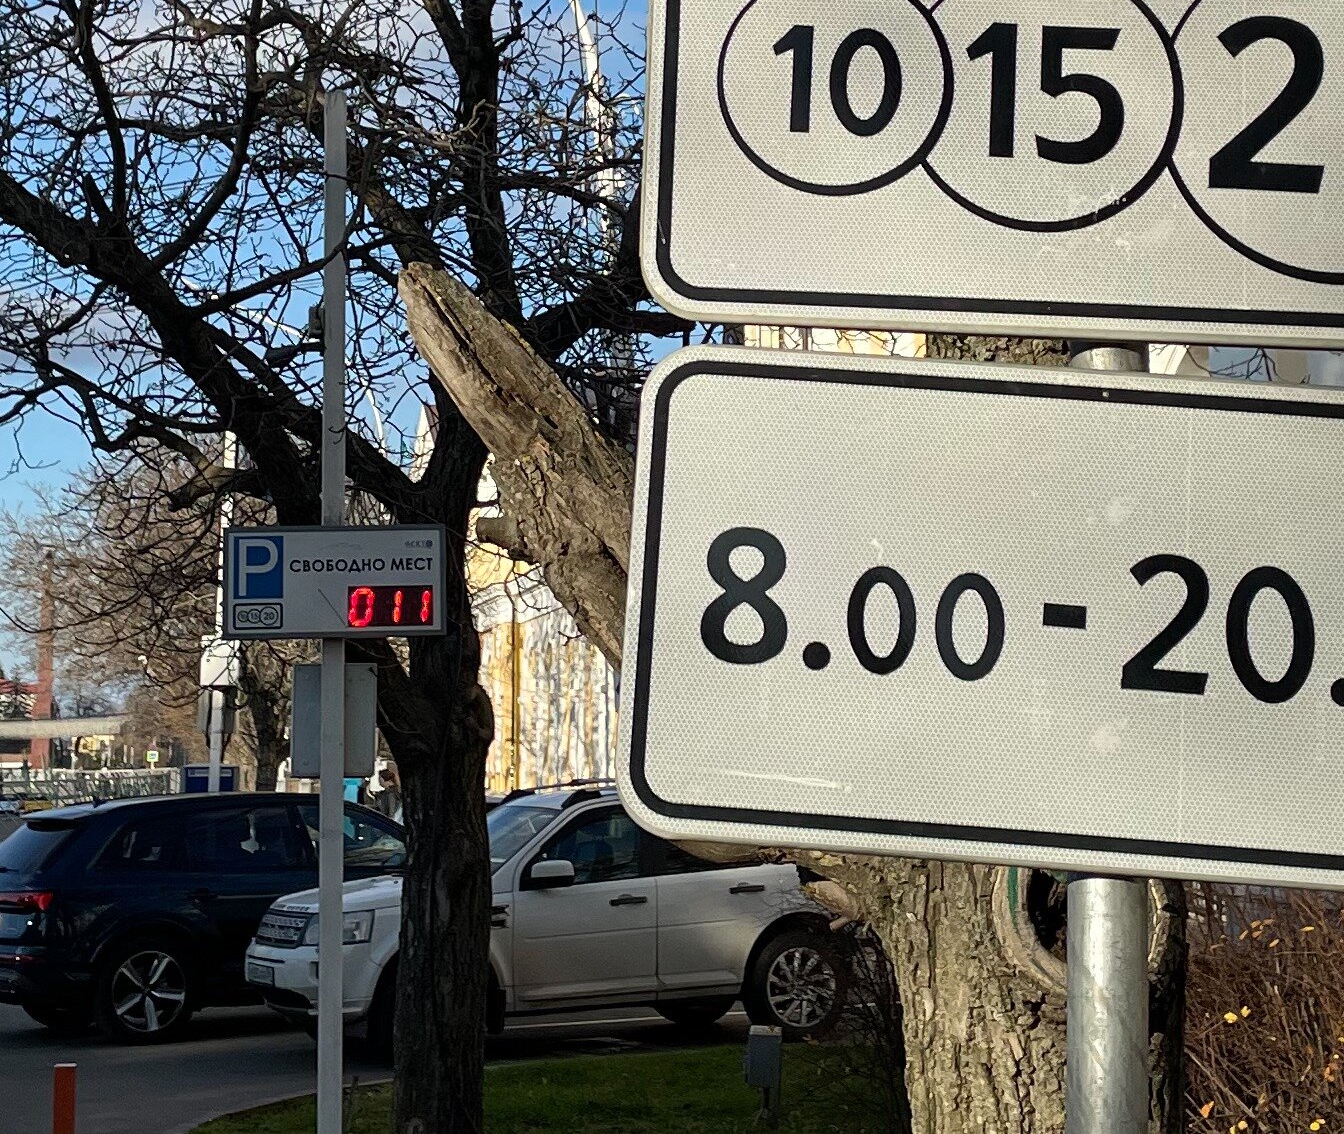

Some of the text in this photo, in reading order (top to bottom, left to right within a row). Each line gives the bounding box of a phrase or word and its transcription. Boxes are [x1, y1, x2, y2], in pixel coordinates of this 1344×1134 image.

[772, 23, 903, 138] 10
[965, 21, 1126, 166] 15
[238, 538, 279, 597] P
[289, 557, 434, 574] СВОБОДНО МЕСТ
[263, 612, 275, 621] 20
[347, 587, 432, 628] 011
